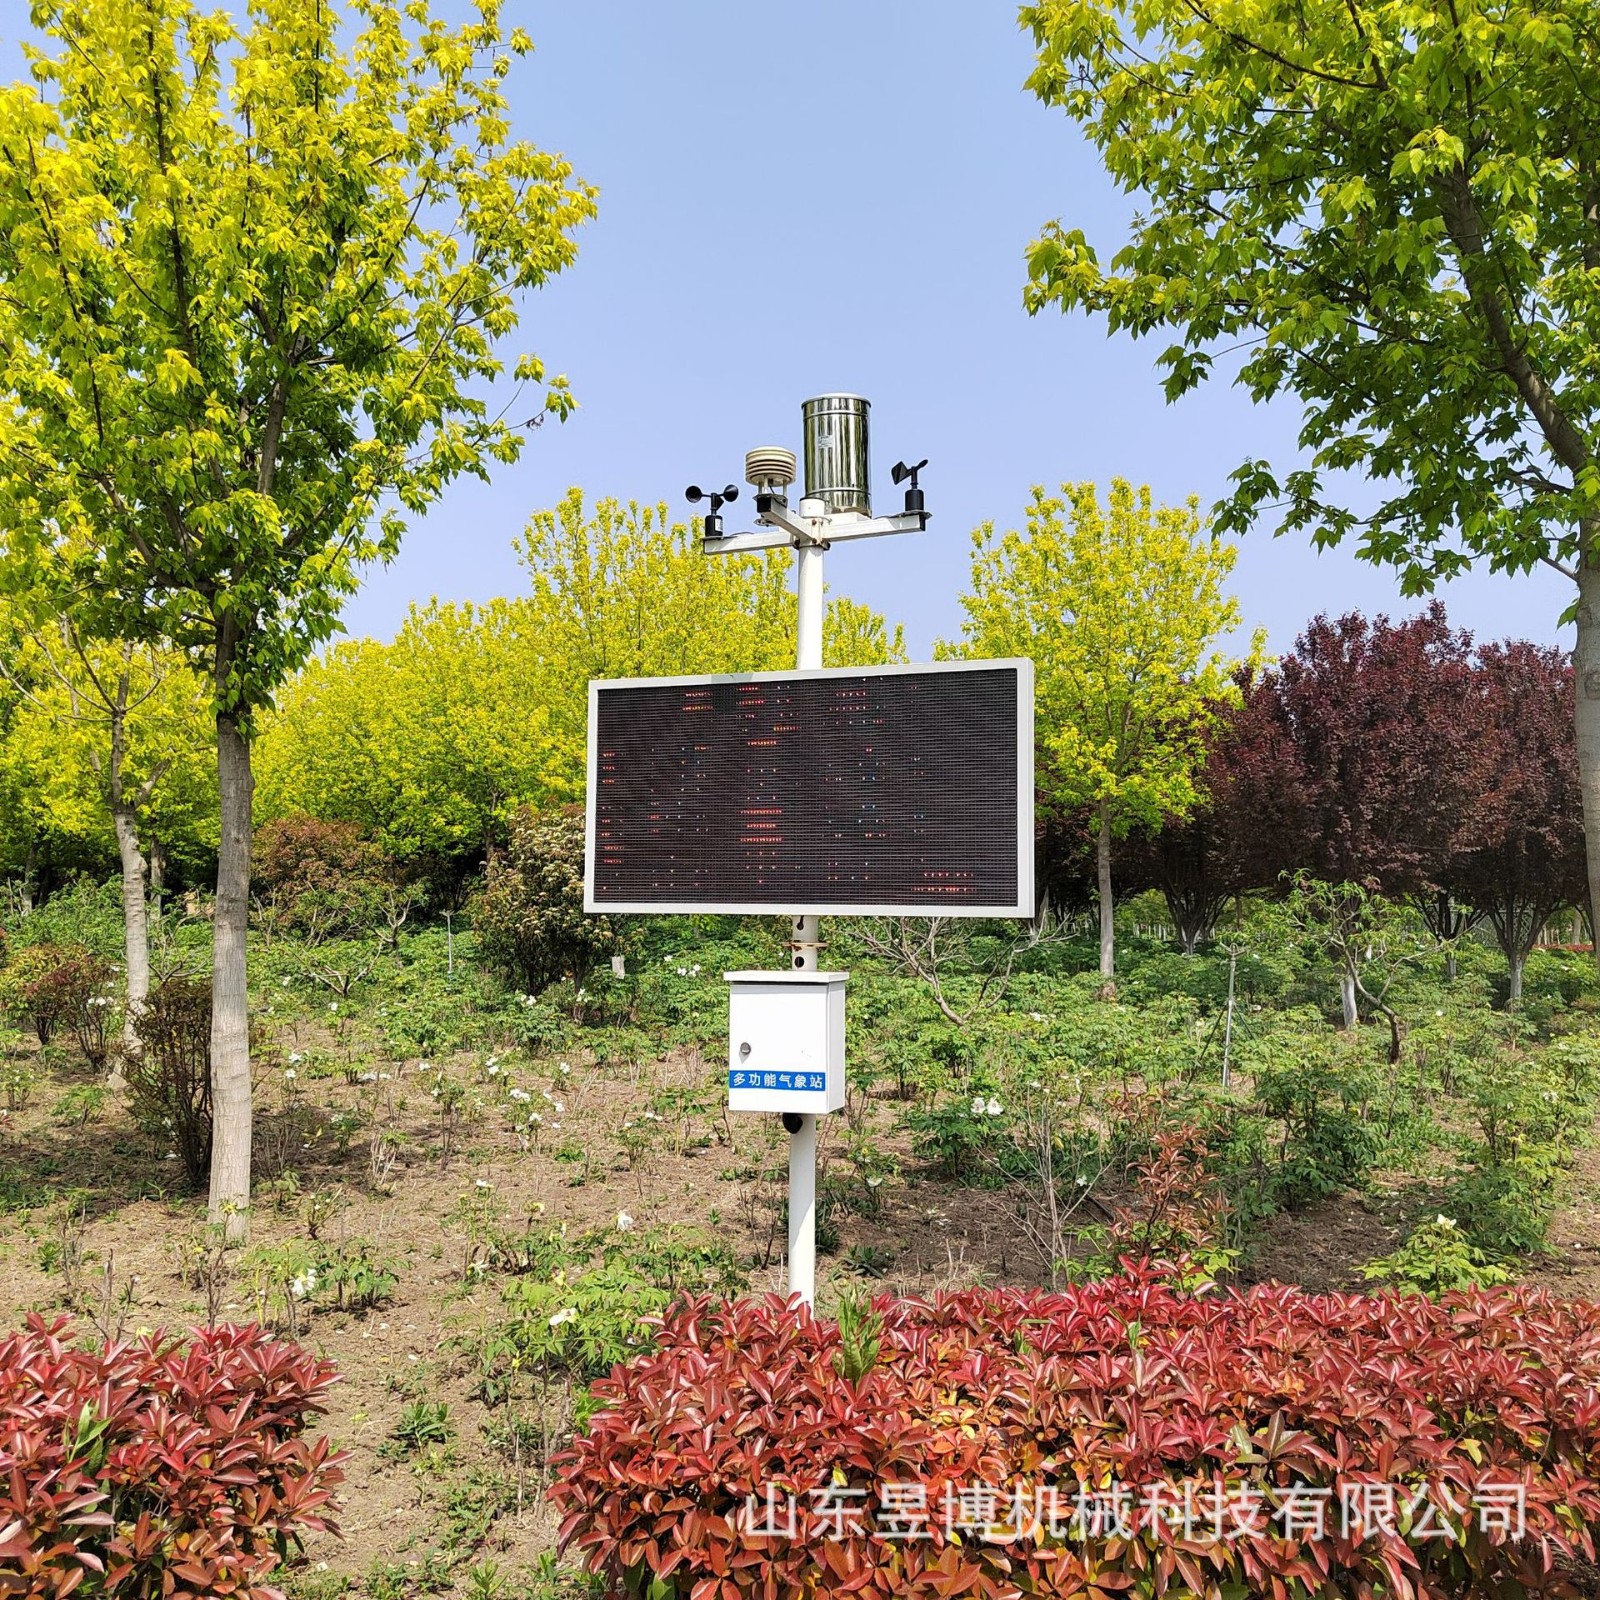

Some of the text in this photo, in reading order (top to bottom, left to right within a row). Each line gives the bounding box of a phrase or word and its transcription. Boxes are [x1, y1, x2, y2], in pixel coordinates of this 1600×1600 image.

[733, 1072, 823, 1089] 多功能气象站
